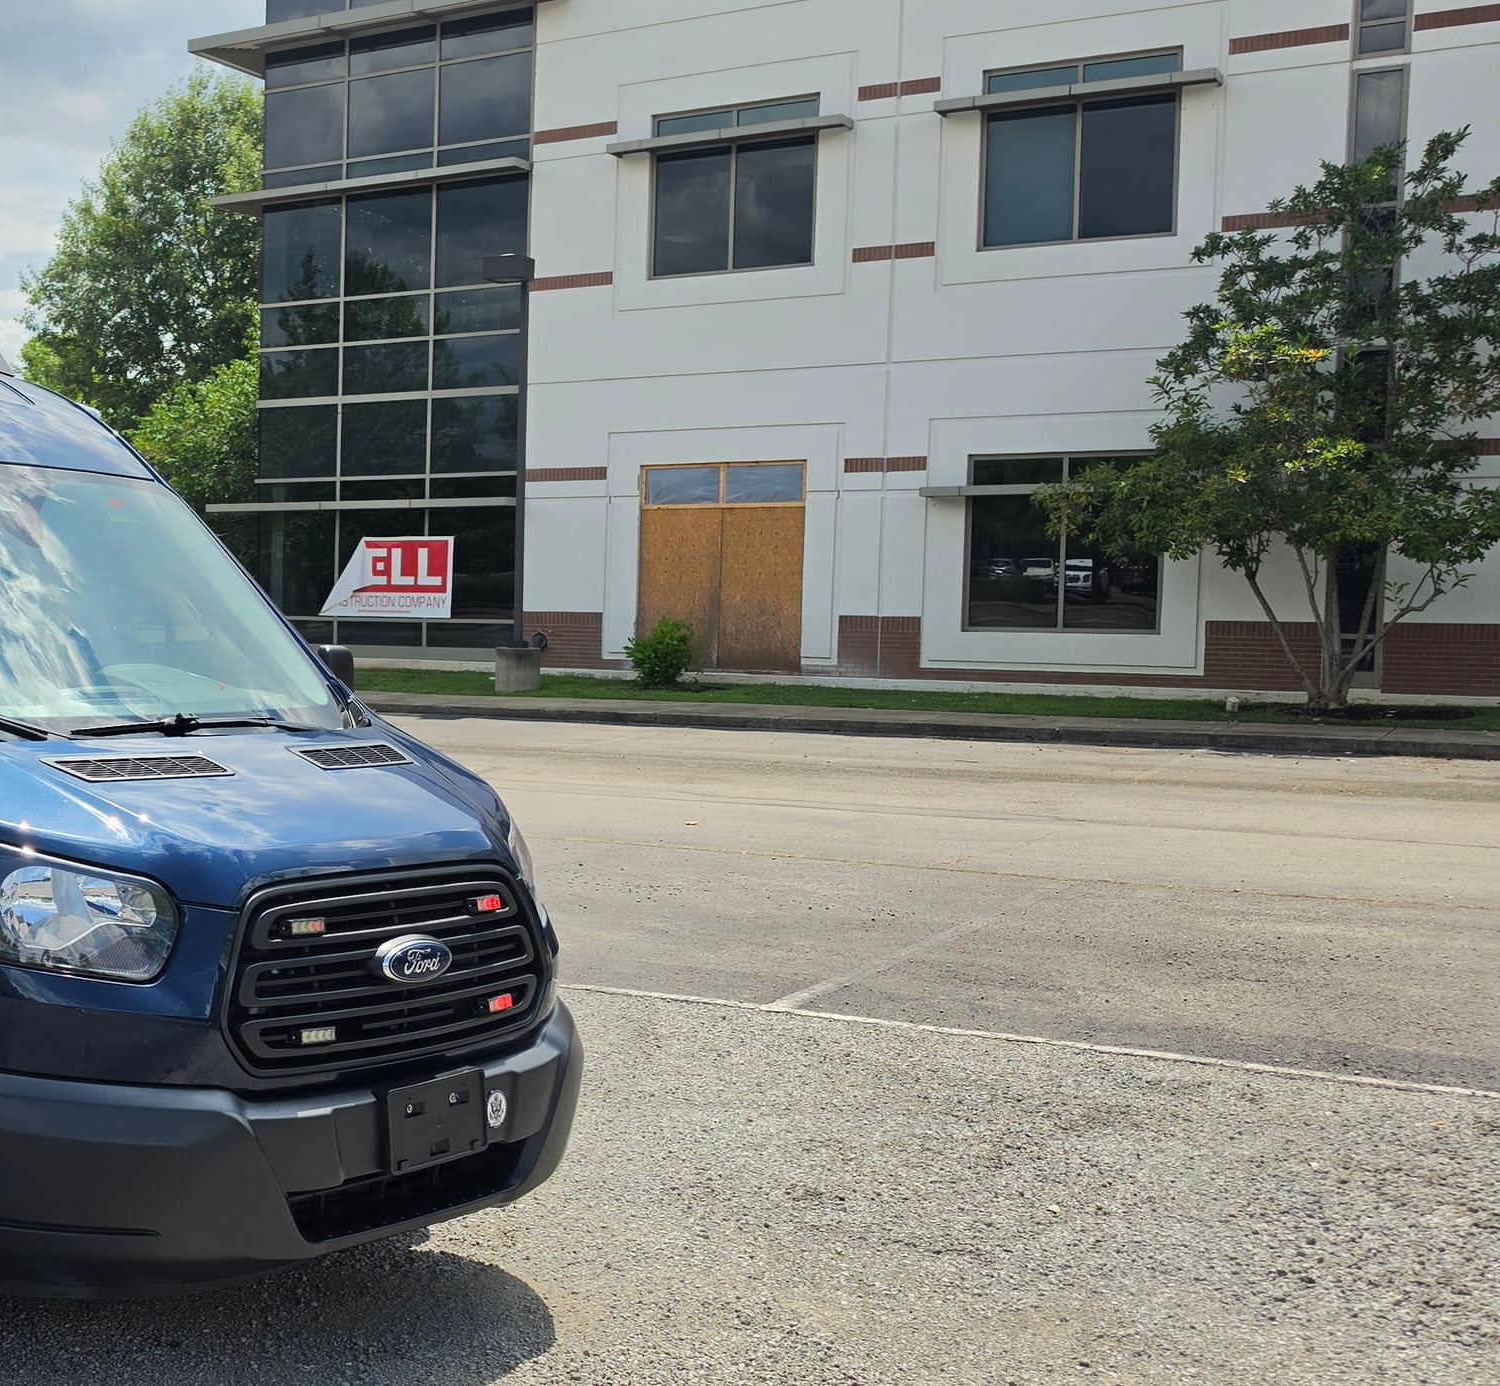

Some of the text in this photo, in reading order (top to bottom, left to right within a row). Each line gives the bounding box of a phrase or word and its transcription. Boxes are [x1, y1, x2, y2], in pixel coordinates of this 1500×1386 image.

[365, 547, 442, 586] ELL
[397, 595, 447, 609] COMPANY
[403, 947, 442, 975] Ford
